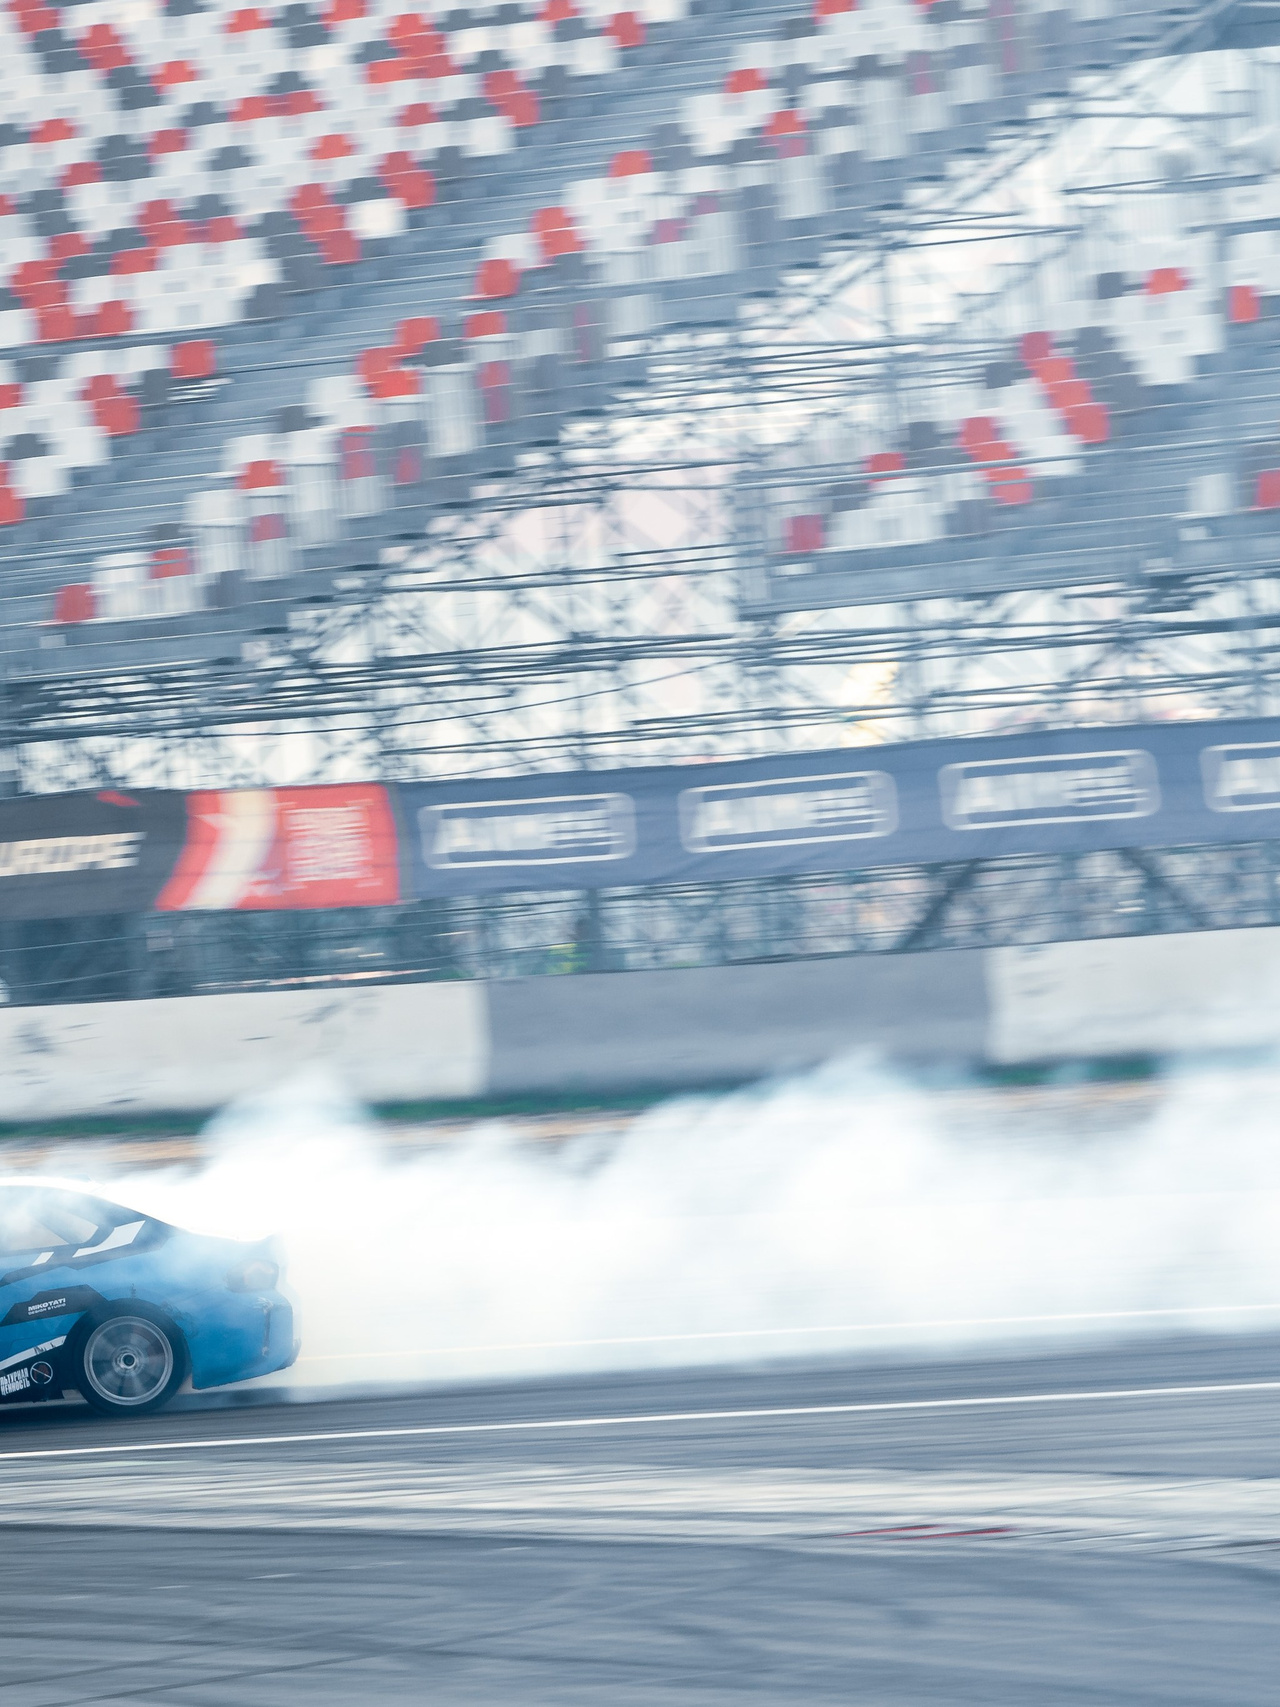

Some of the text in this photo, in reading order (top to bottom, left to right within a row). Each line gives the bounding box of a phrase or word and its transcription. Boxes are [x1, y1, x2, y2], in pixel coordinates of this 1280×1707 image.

[27, 1298, 66, 1312] MIKOTATI
[27, 1302, 66, 1316] DESIGN STUDIO
[1, 1378, 31, 1397] ЦЕННОСТЬ
